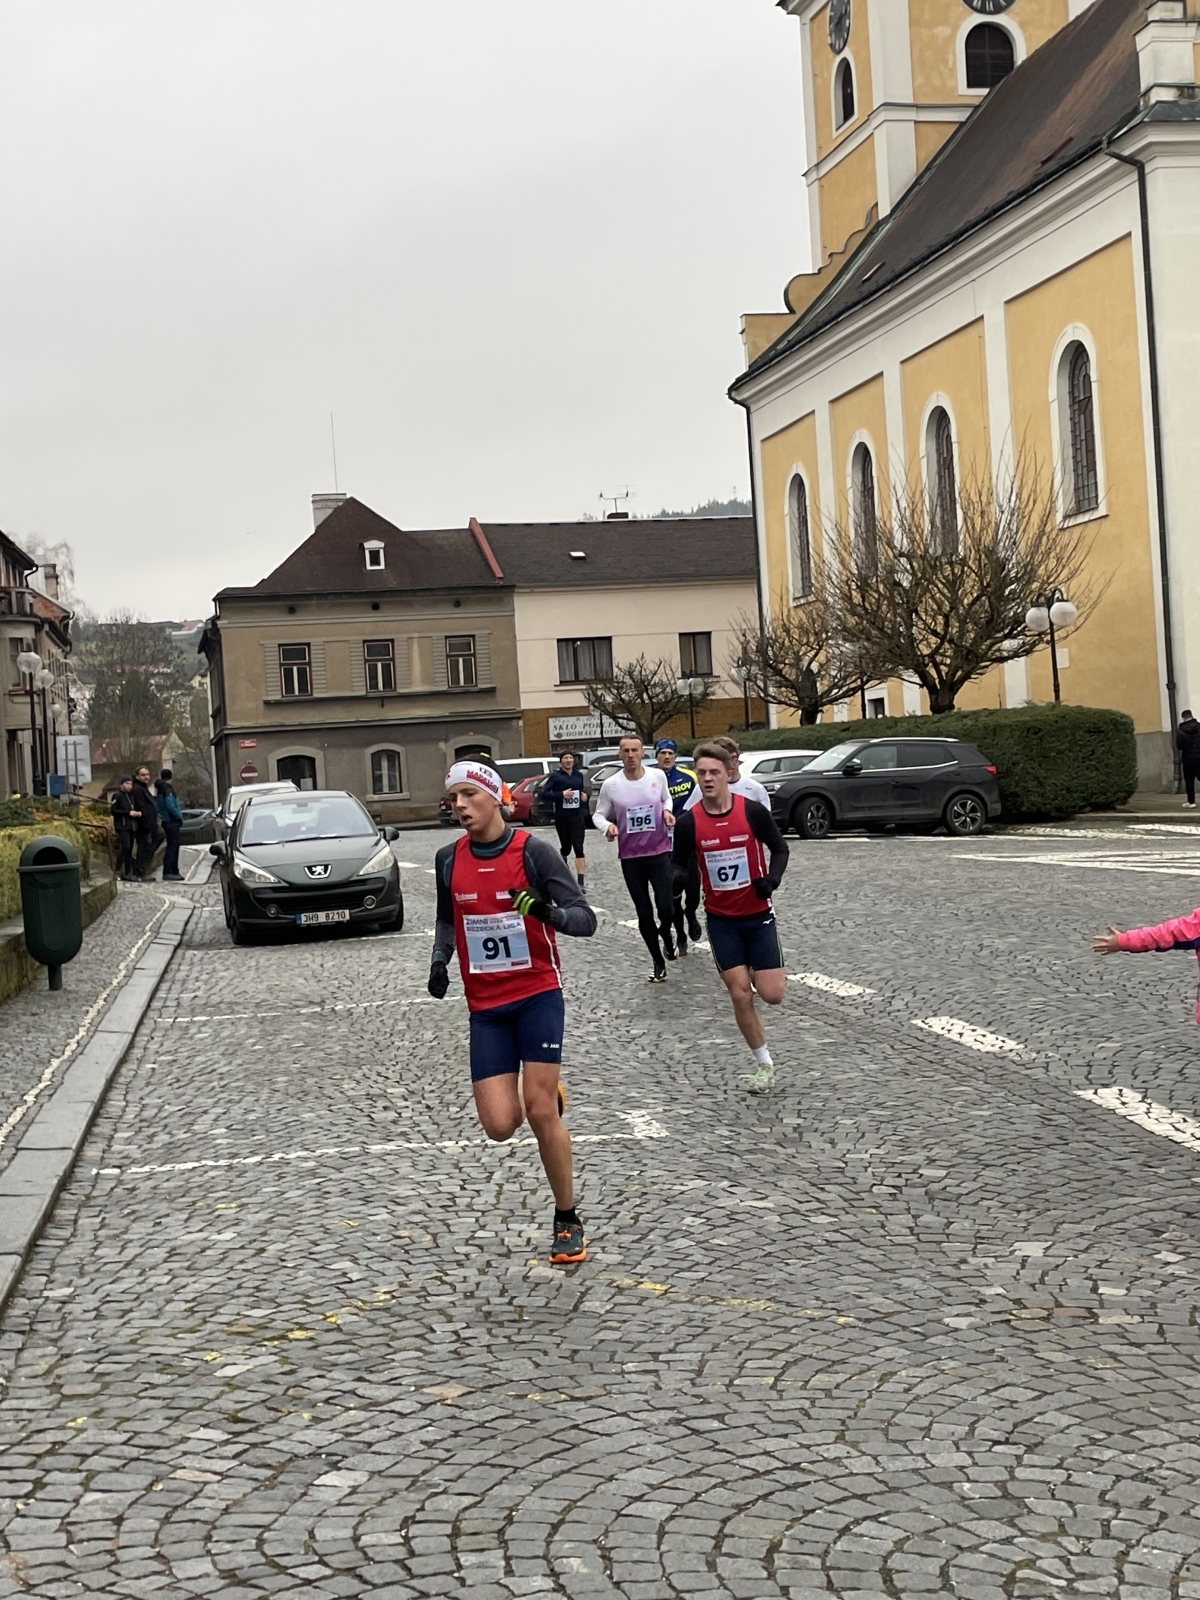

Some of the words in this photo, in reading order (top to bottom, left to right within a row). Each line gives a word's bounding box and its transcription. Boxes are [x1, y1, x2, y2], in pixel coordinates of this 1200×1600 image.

[553, 723, 577, 731] SKLO
[629, 815, 652, 827] 196
[717, 864, 739, 882] 67
[303, 914, 319, 922] 3H9
[325, 911, 346, 921] 8210
[504, 921, 522, 929] LIGA
[482, 935, 512, 960] 91
